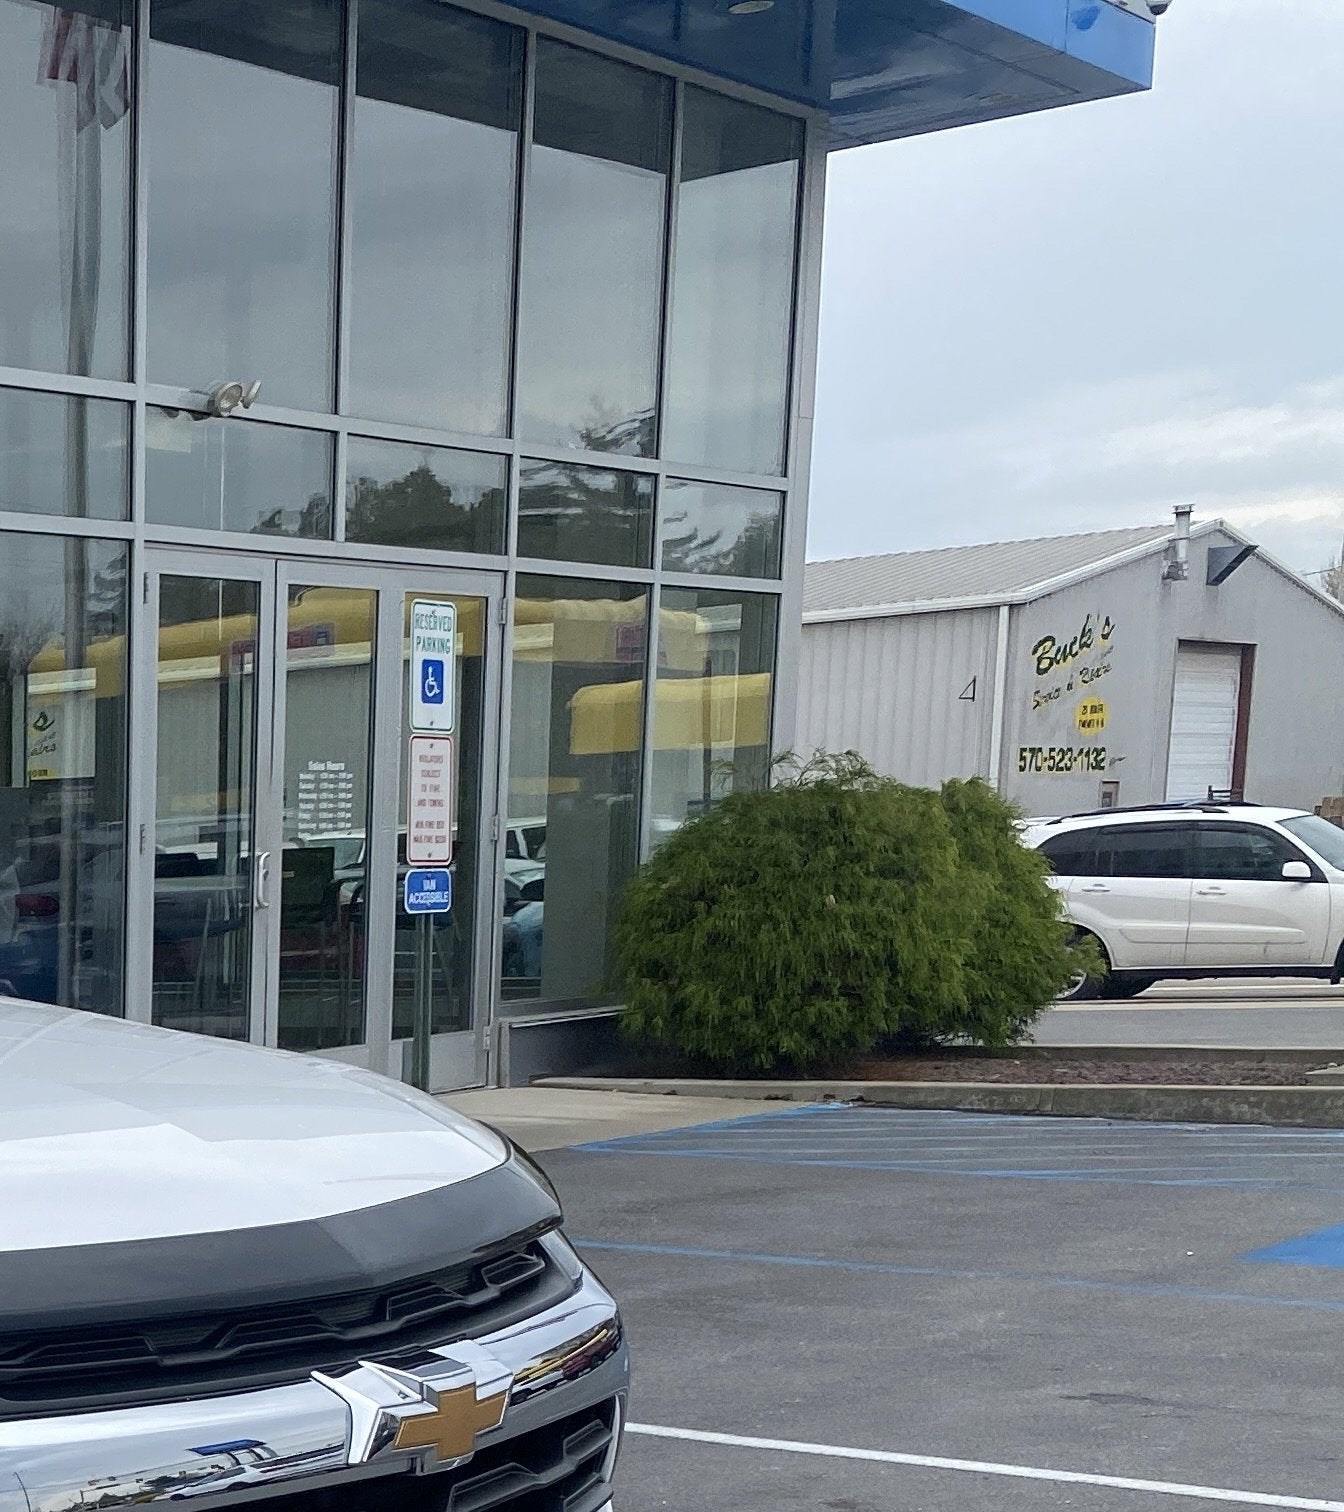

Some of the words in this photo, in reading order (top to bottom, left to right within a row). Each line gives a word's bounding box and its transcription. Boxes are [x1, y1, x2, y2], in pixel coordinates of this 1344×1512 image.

[414, 612, 452, 632] RESERVED
[415, 635, 451, 654] PARKING
[1031, 612, 1116, 676] Buck's
[1018, 746, 1107, 772] 570-523-1132
[422, 879, 437, 890] VAN
[408, 890, 449, 904] ACCESSIBLE
